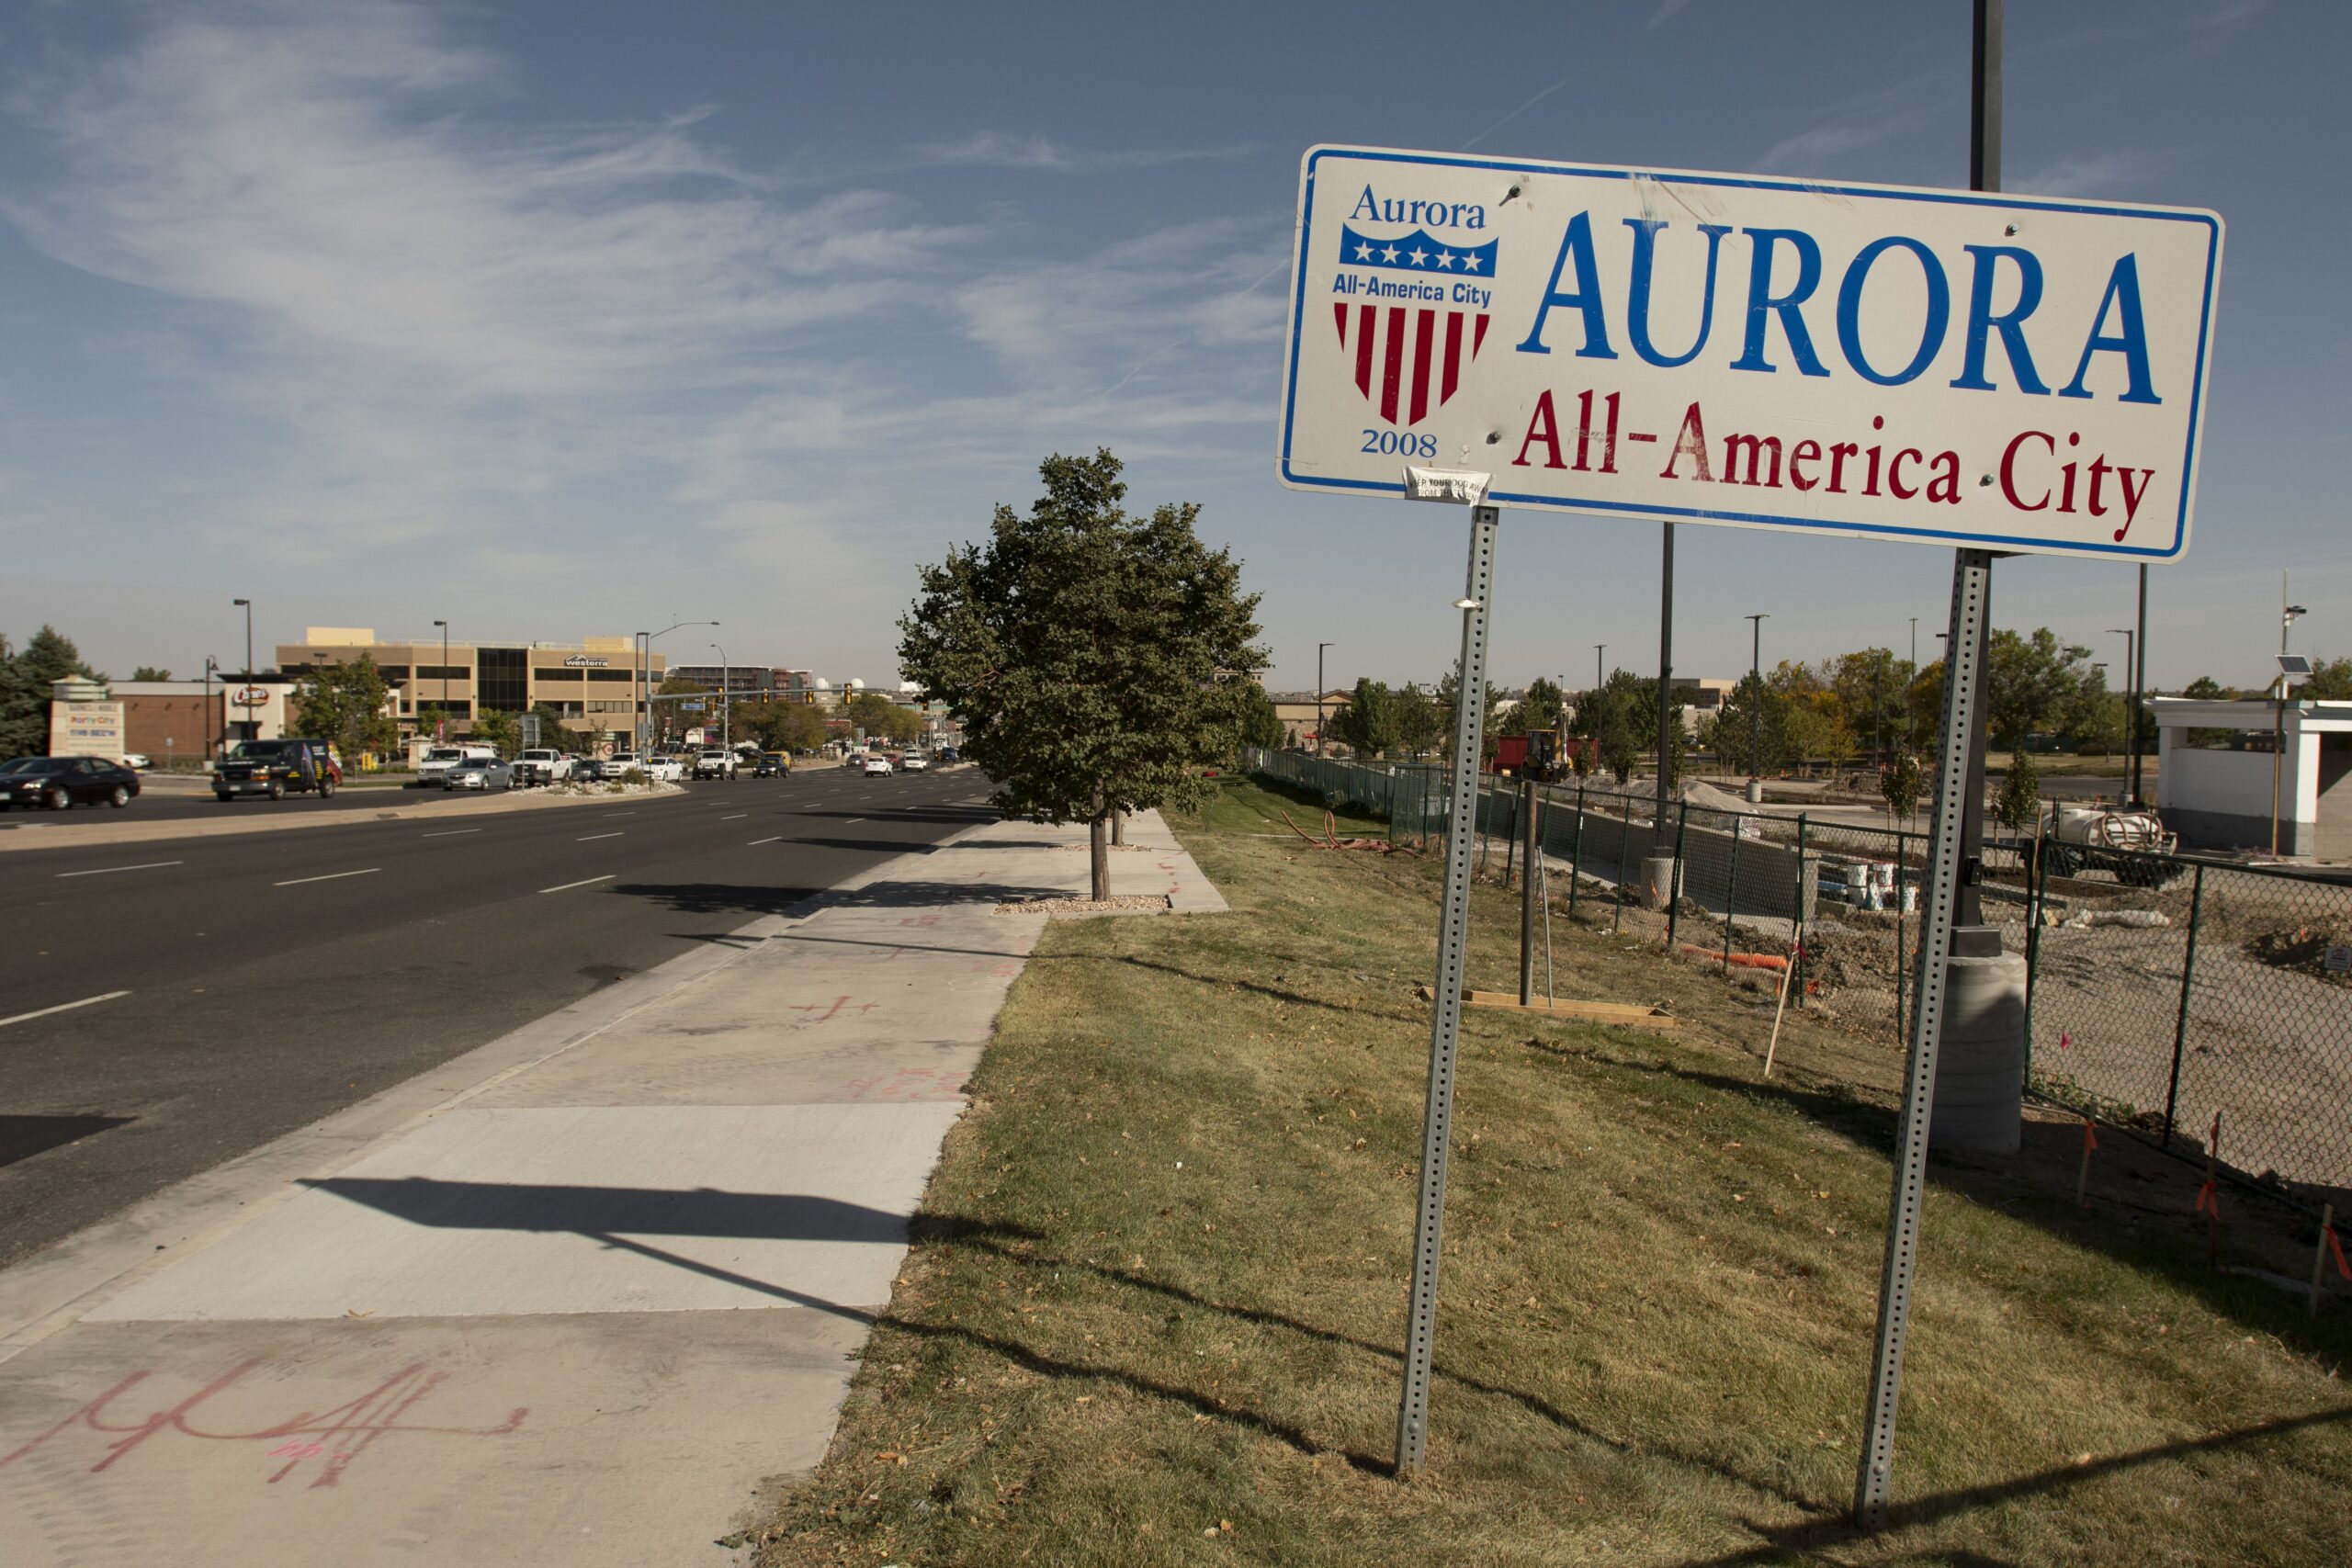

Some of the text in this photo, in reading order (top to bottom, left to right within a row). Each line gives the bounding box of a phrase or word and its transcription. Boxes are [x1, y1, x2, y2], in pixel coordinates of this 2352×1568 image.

[1348, 183, 1487, 230] Aurora
[1332, 273, 1492, 310] All-America City
[1516, 209, 2162, 405] AURORA
[1360, 429, 1438, 458] 2008
[1429, 478, 1451, 488] YOUR
[1511, 389, 2156, 542] All-America City
[565, 659, 608, 667] westerra
